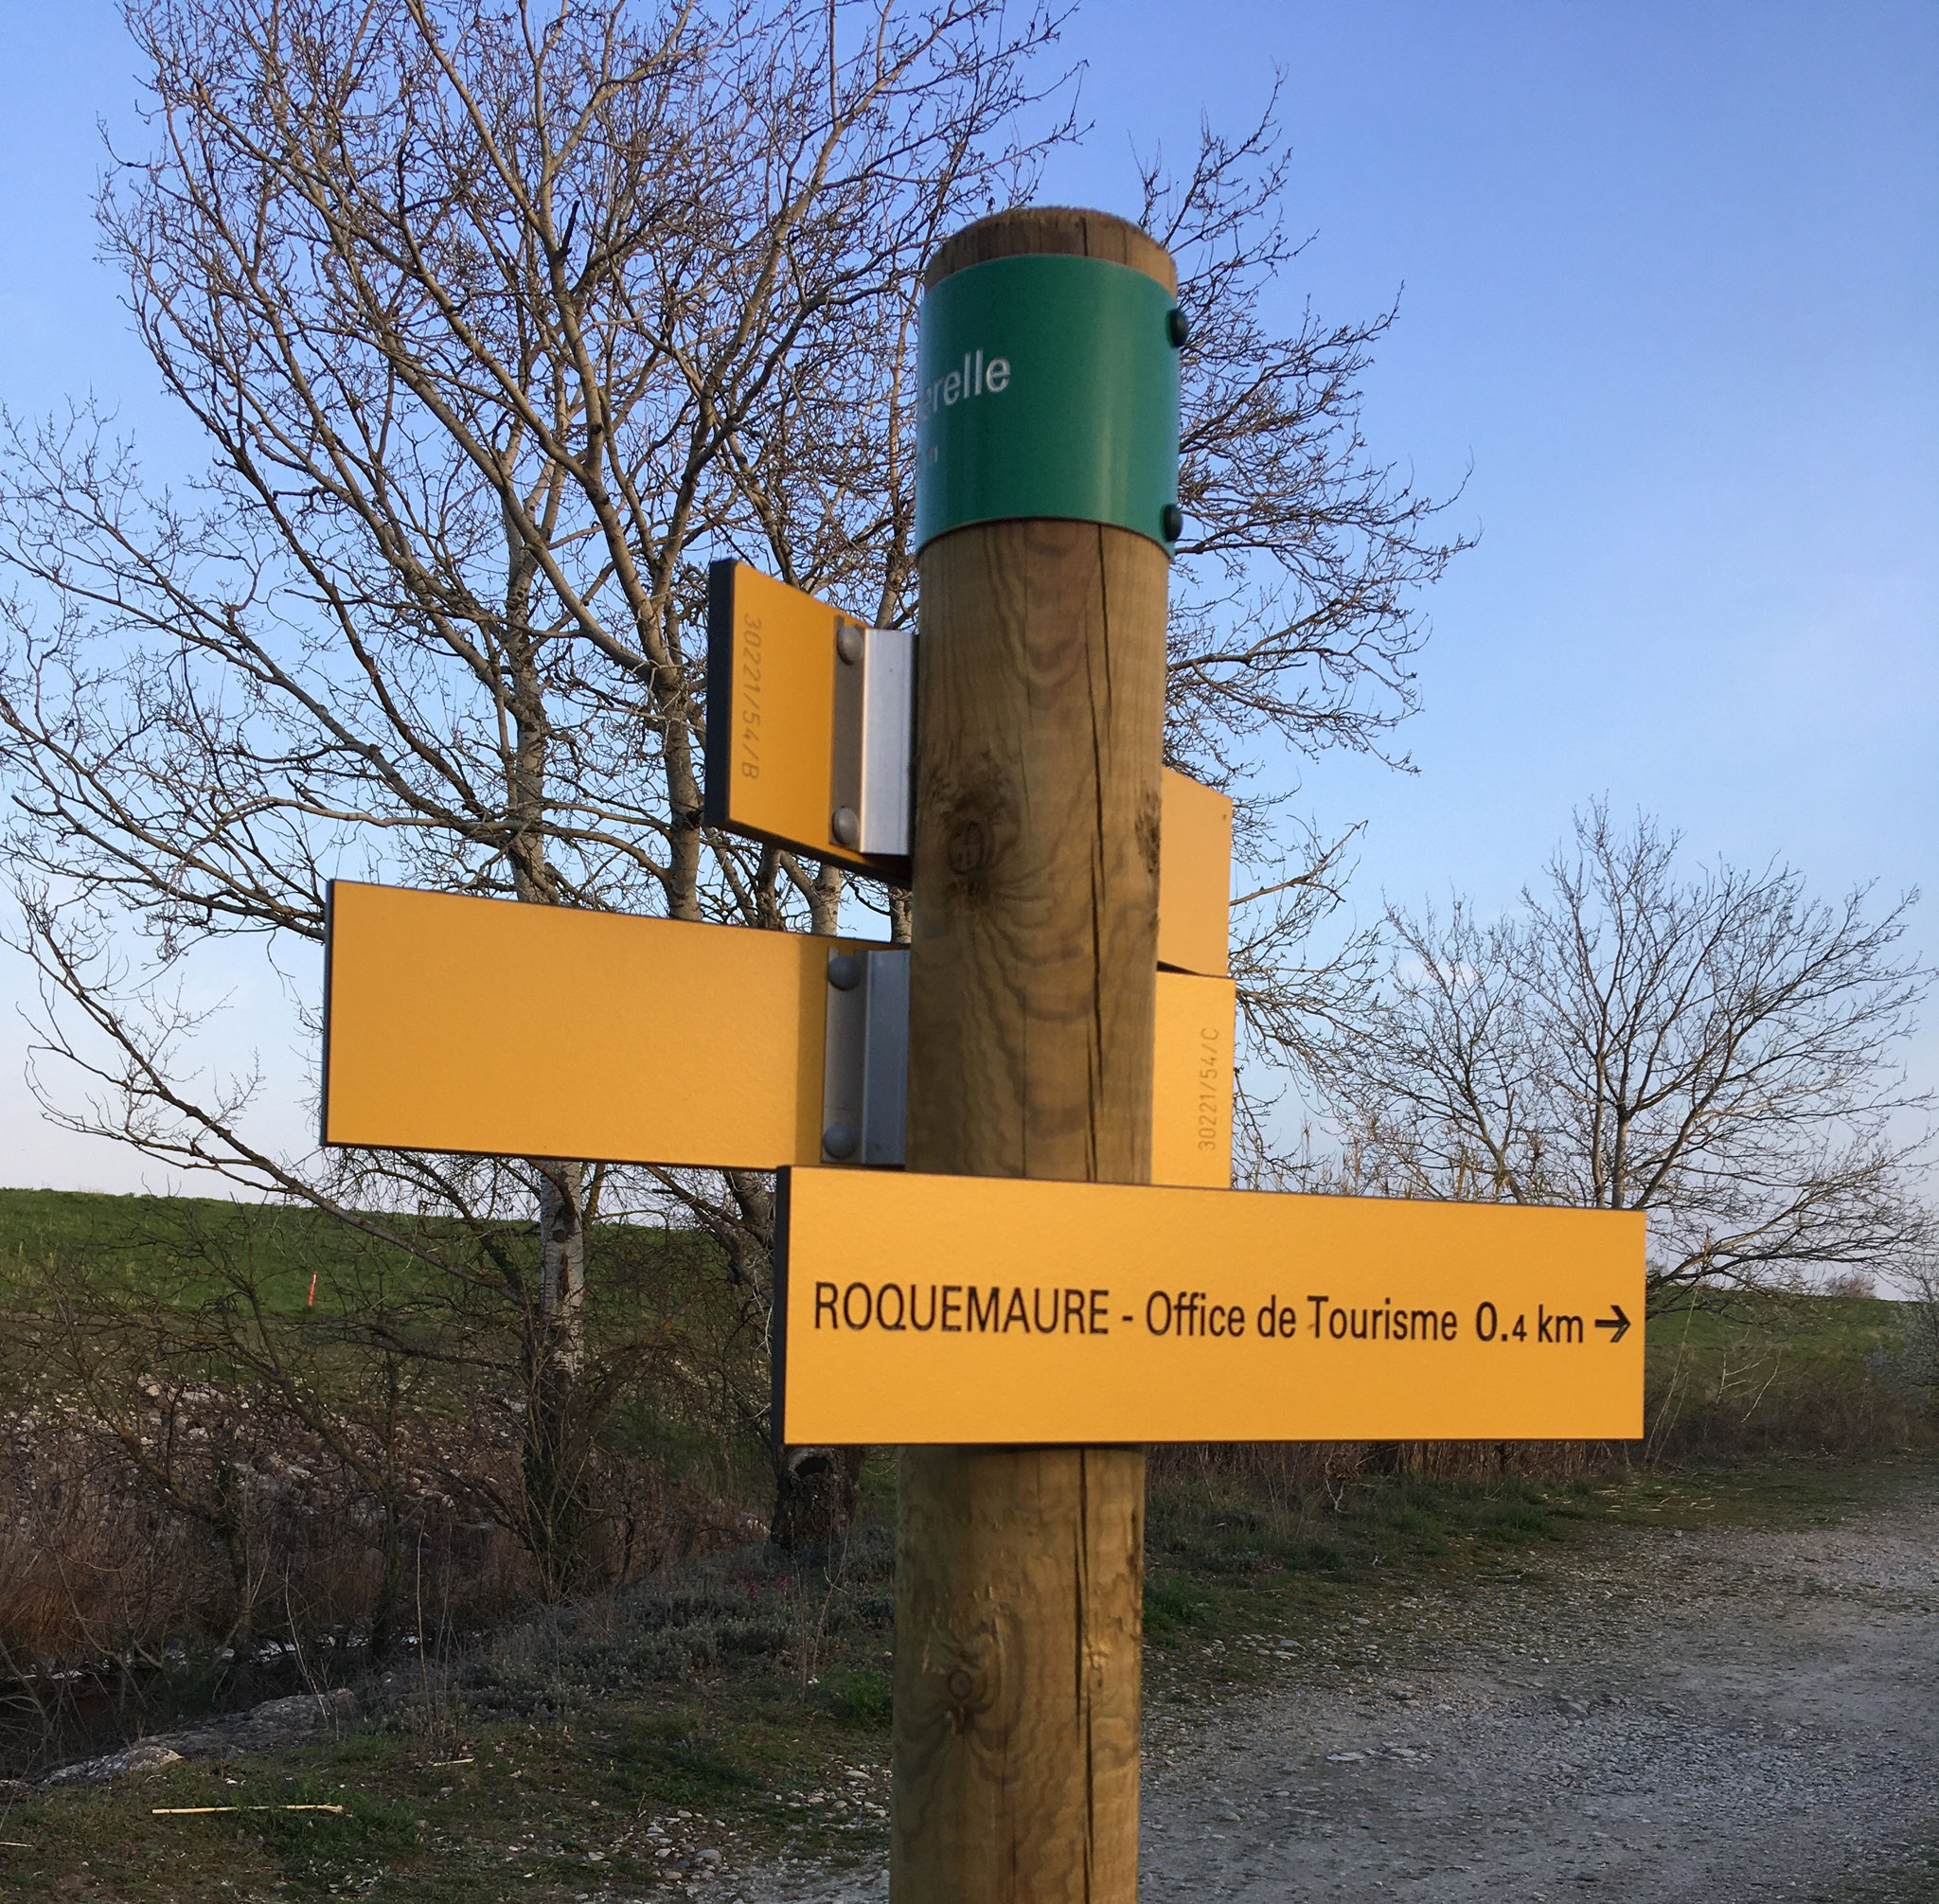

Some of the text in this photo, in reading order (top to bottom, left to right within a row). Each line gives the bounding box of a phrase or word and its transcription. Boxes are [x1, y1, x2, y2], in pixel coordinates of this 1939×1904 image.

[741, 613, 762, 780] 30221/54/B
[1198, 1027, 1219, 1151] 30221/54/C
[813, 1281, 1109, 1335] ROQUEMAURE
[1146, 1290, 1245, 1338] Office
[1256, 1294, 1296, 1339] de
[1307, 1295, 1458, 1342] Tourisme
[1475, 1301, 1528, 1343] 0.4
[1538, 1304, 1584, 1343] km
